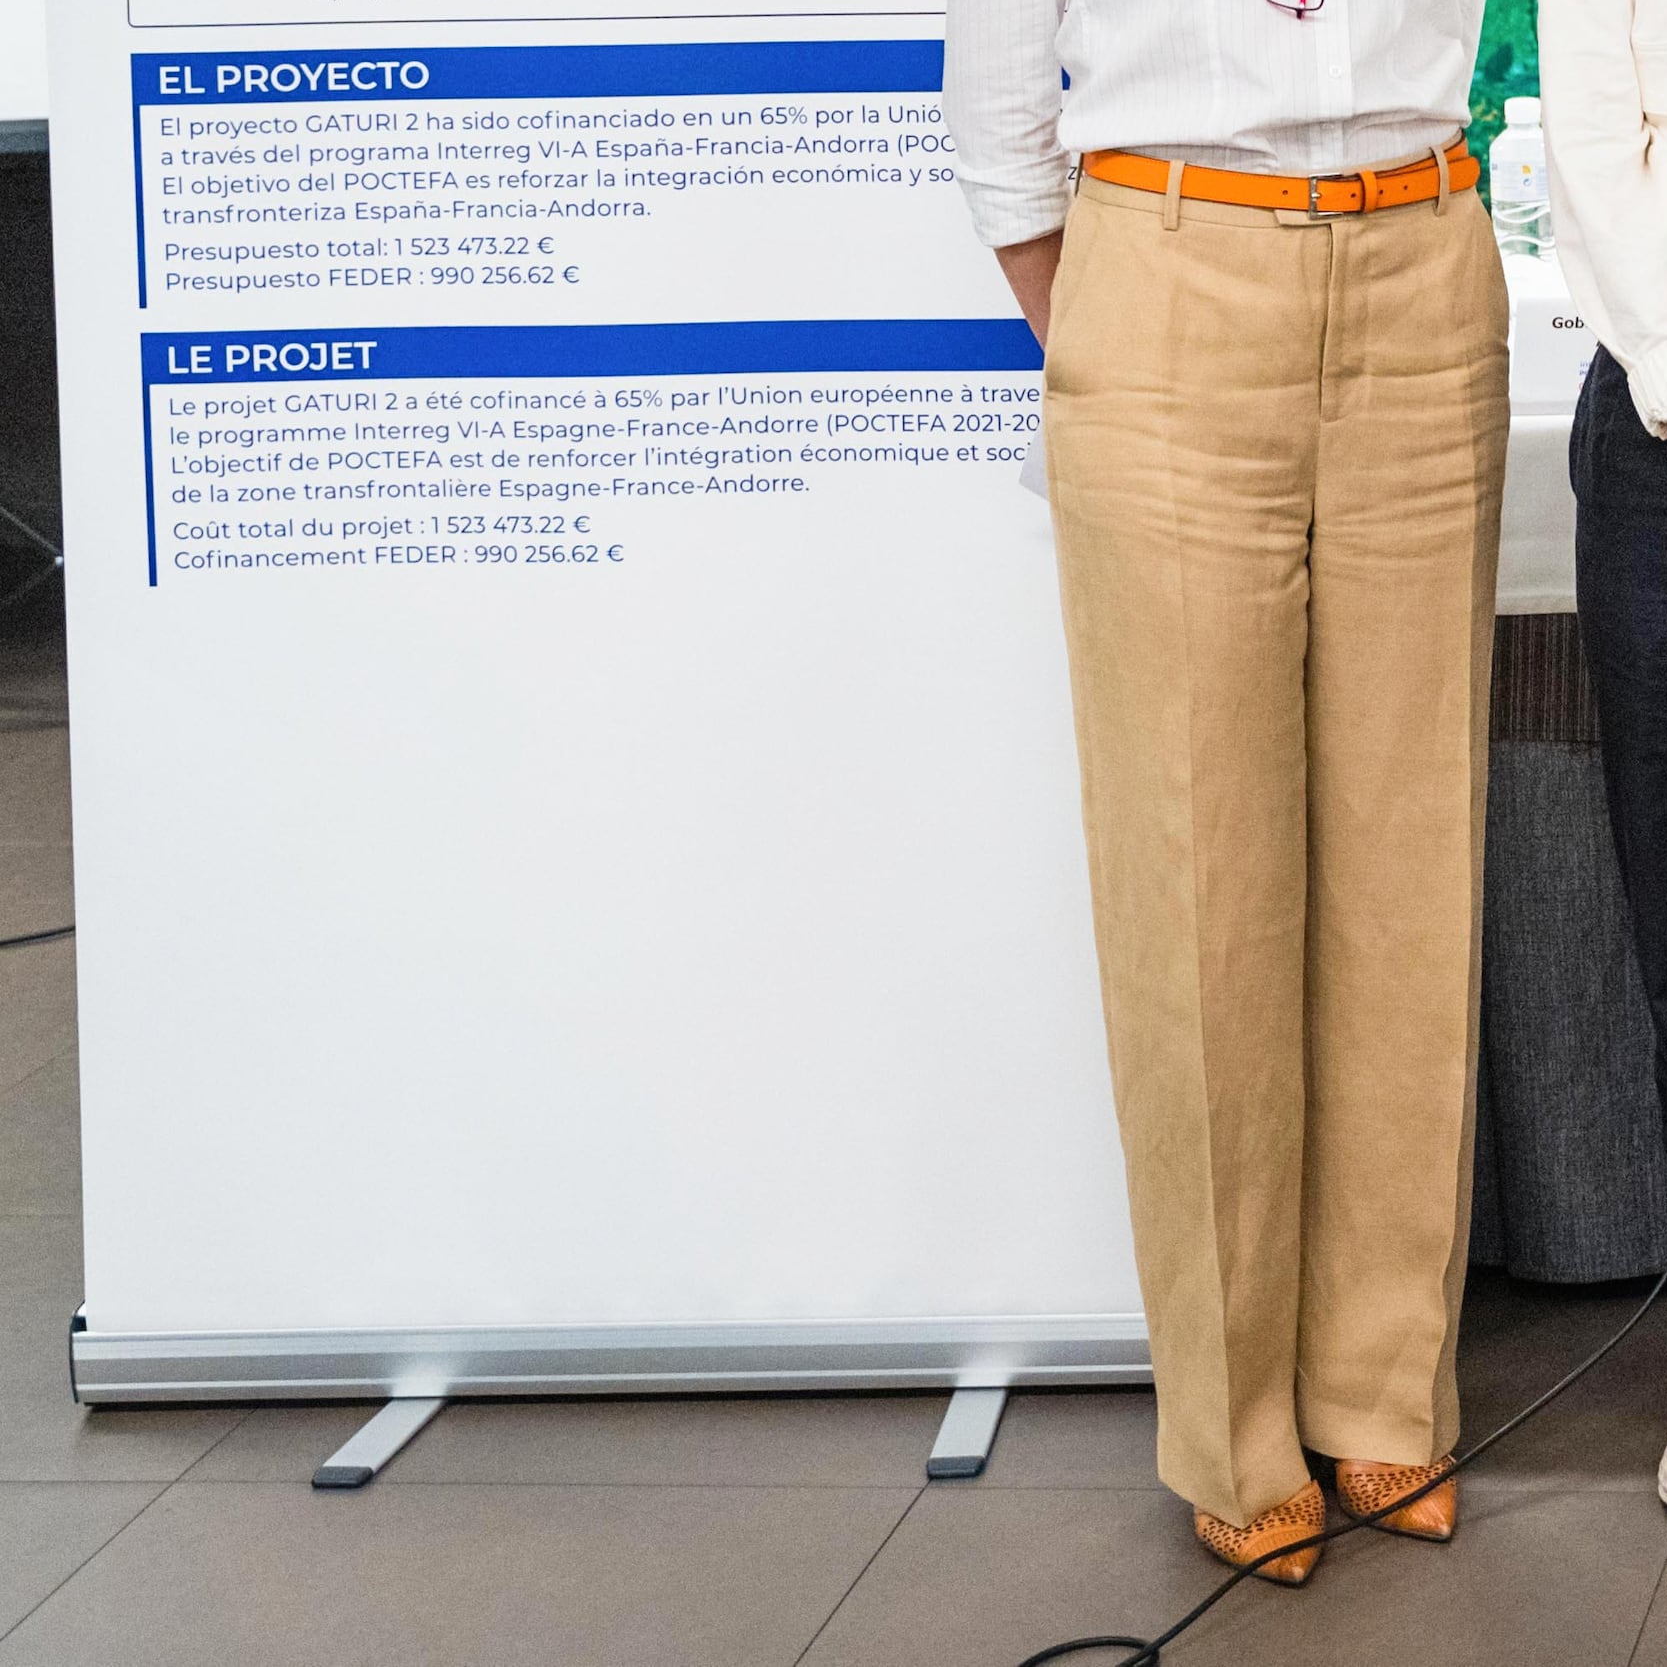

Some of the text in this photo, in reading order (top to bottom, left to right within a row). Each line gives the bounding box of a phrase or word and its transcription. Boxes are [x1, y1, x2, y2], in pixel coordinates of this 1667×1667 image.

[159, 60, 430, 95] EL PROYECTO
[165, 236, 555, 265] Presupuesto total: 1 523 473.22 €
[1551, 316, 1585, 329] Gob
